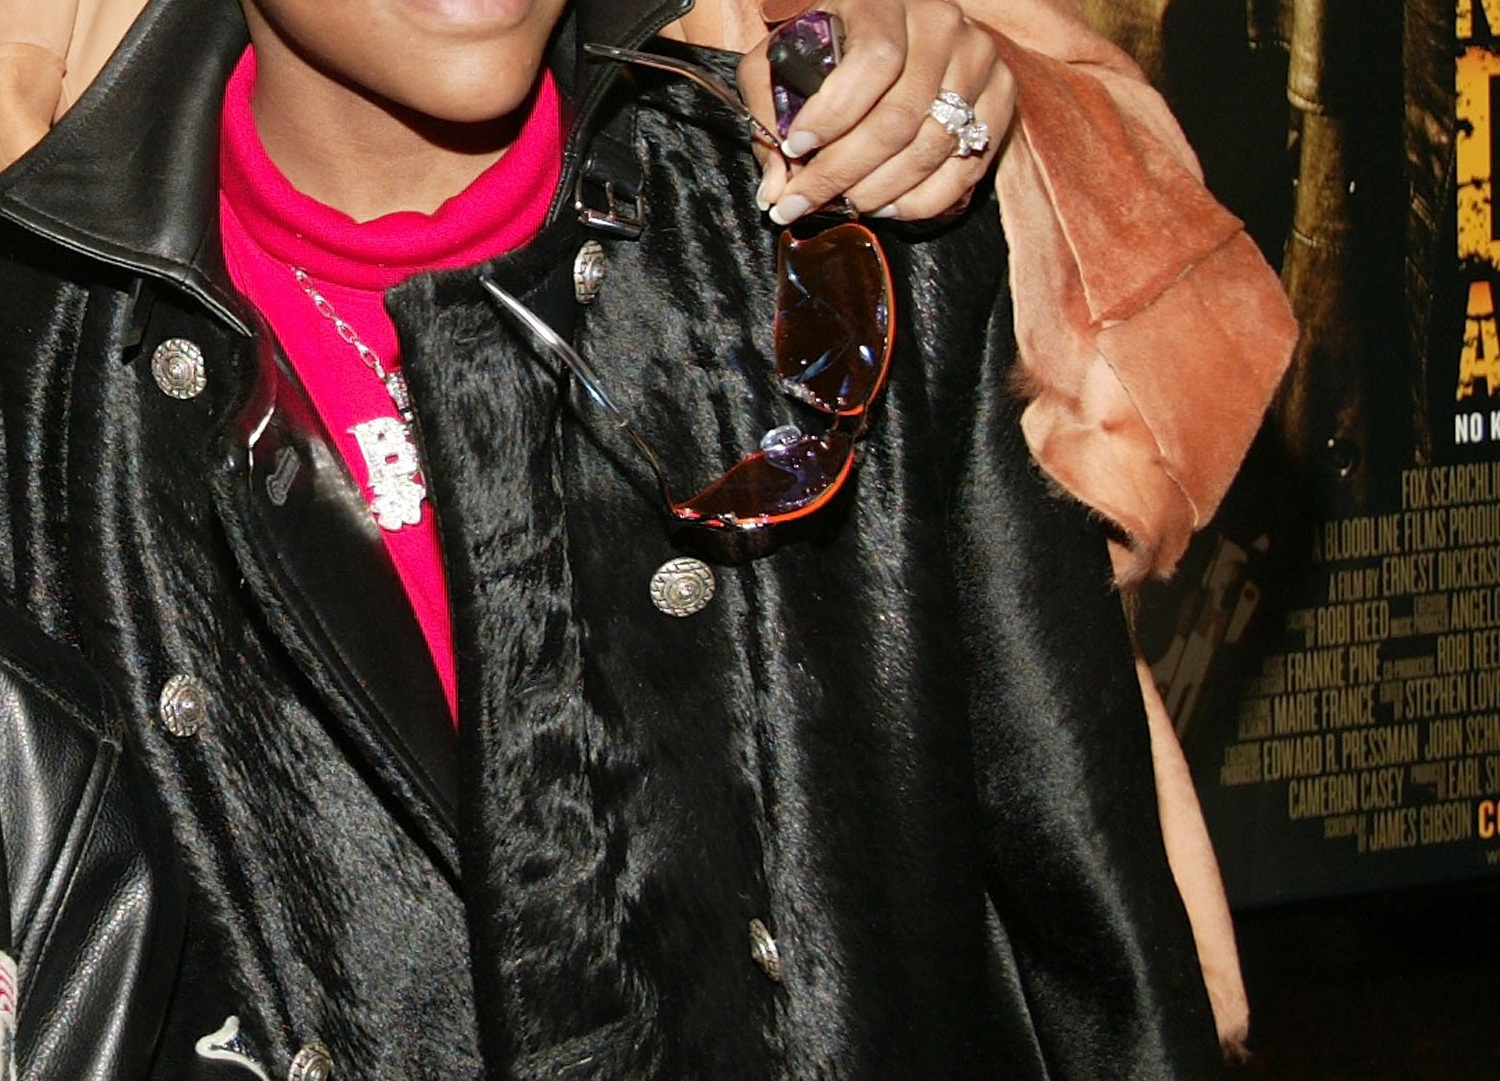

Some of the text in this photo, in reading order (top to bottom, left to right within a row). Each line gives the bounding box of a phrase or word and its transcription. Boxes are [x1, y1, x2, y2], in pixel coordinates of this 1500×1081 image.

[1454, 412, 1484, 445] NO
[1402, 466, 1428, 510] FOX
[1325, 514, 1400, 561] BLOODLINE
[1404, 508, 1447, 553] FILMS
[1382, 553, 1434, 597] ERNEST
[1317, 603, 1350, 647] ROBI
[1354, 599, 1390, 641] REED
[1287, 647, 1346, 692] FRANKIE
[1349, 642, 1381, 686] PINE
[1436, 631, 1470, 674] ROBI
[1273, 691, 1318, 735] MARIE
[1321, 685, 1376, 729] FRANCE
[1405, 673, 1467, 718] STEPHEN
[1263, 735, 1323, 781] EDWARD
[1342, 723, 1419, 769] PRESSMAN
[1425, 719, 1463, 760] JOHN
[1288, 774, 1358, 819] CAMERON
[1360, 767, 1405, 810] CASEY
[1449, 757, 1481, 799] EARL
[1369, 806, 1416, 853] JAMES
[1419, 801, 1472, 845] GIBSON
